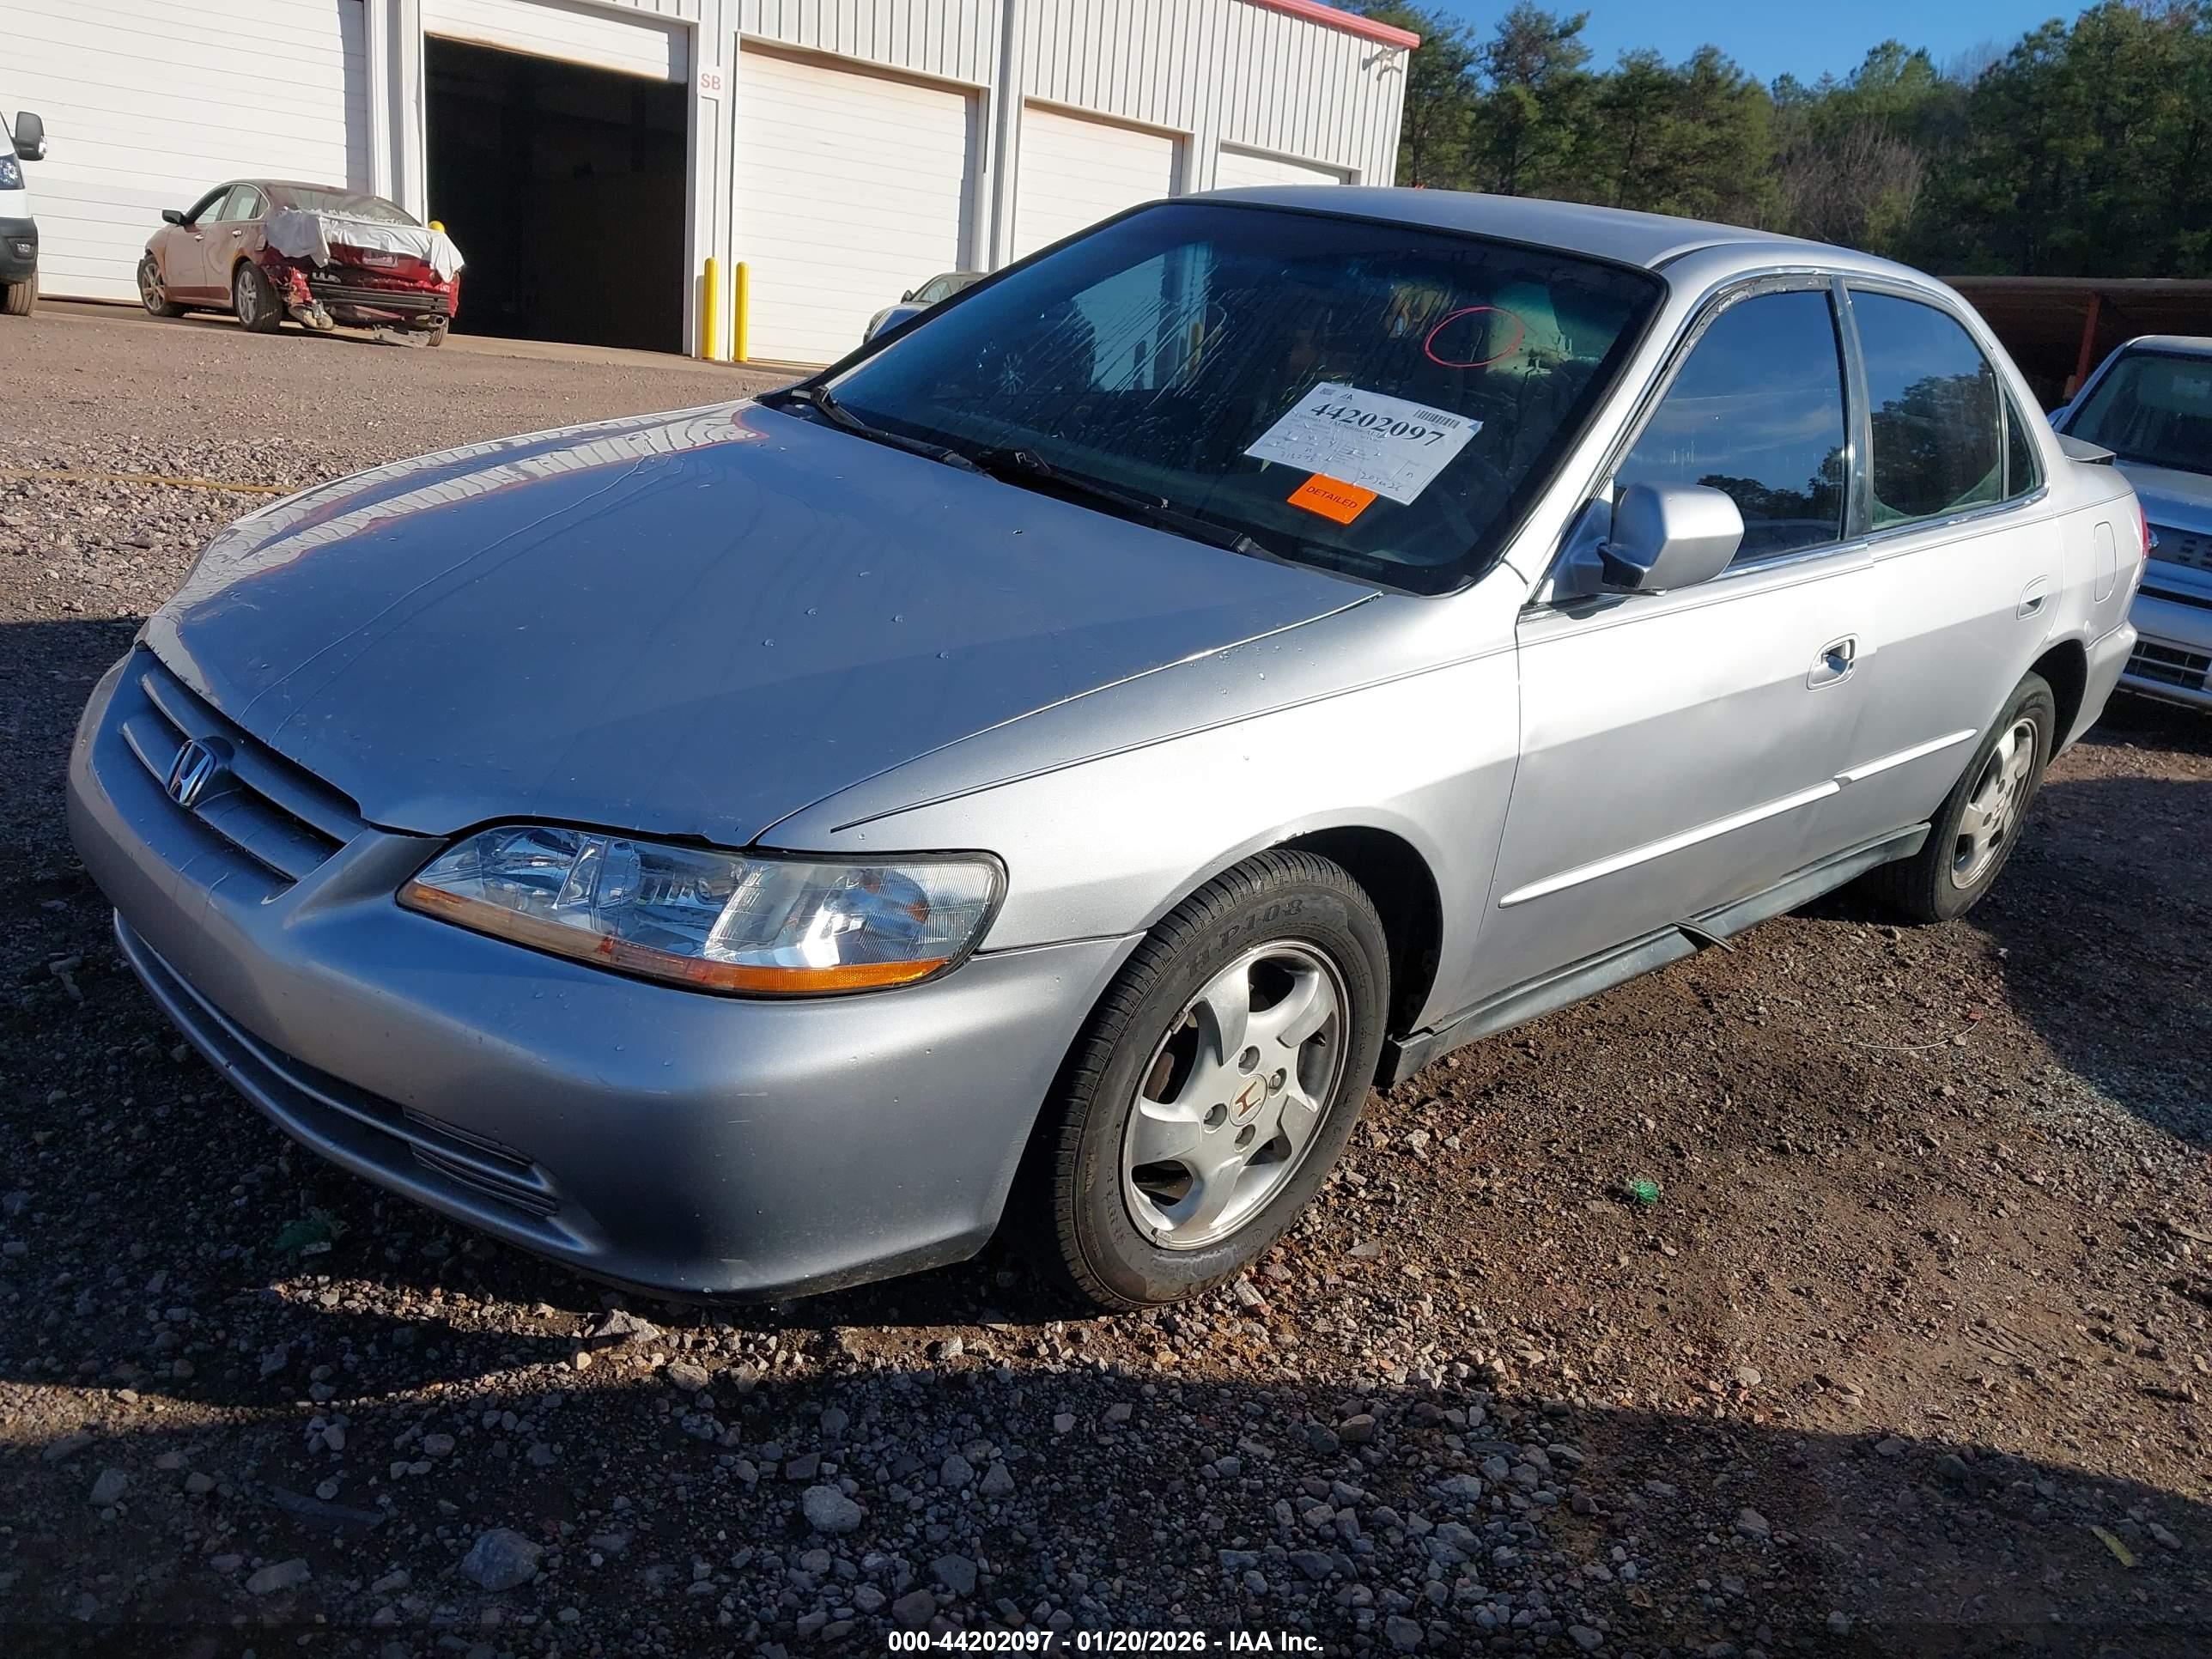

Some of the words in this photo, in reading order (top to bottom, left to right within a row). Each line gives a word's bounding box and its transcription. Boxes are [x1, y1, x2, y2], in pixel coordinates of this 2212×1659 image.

[700, 72, 721, 90] SB
[1310, 403, 1446, 447] 44202097
[1305, 485, 1358, 509] DETAILED
